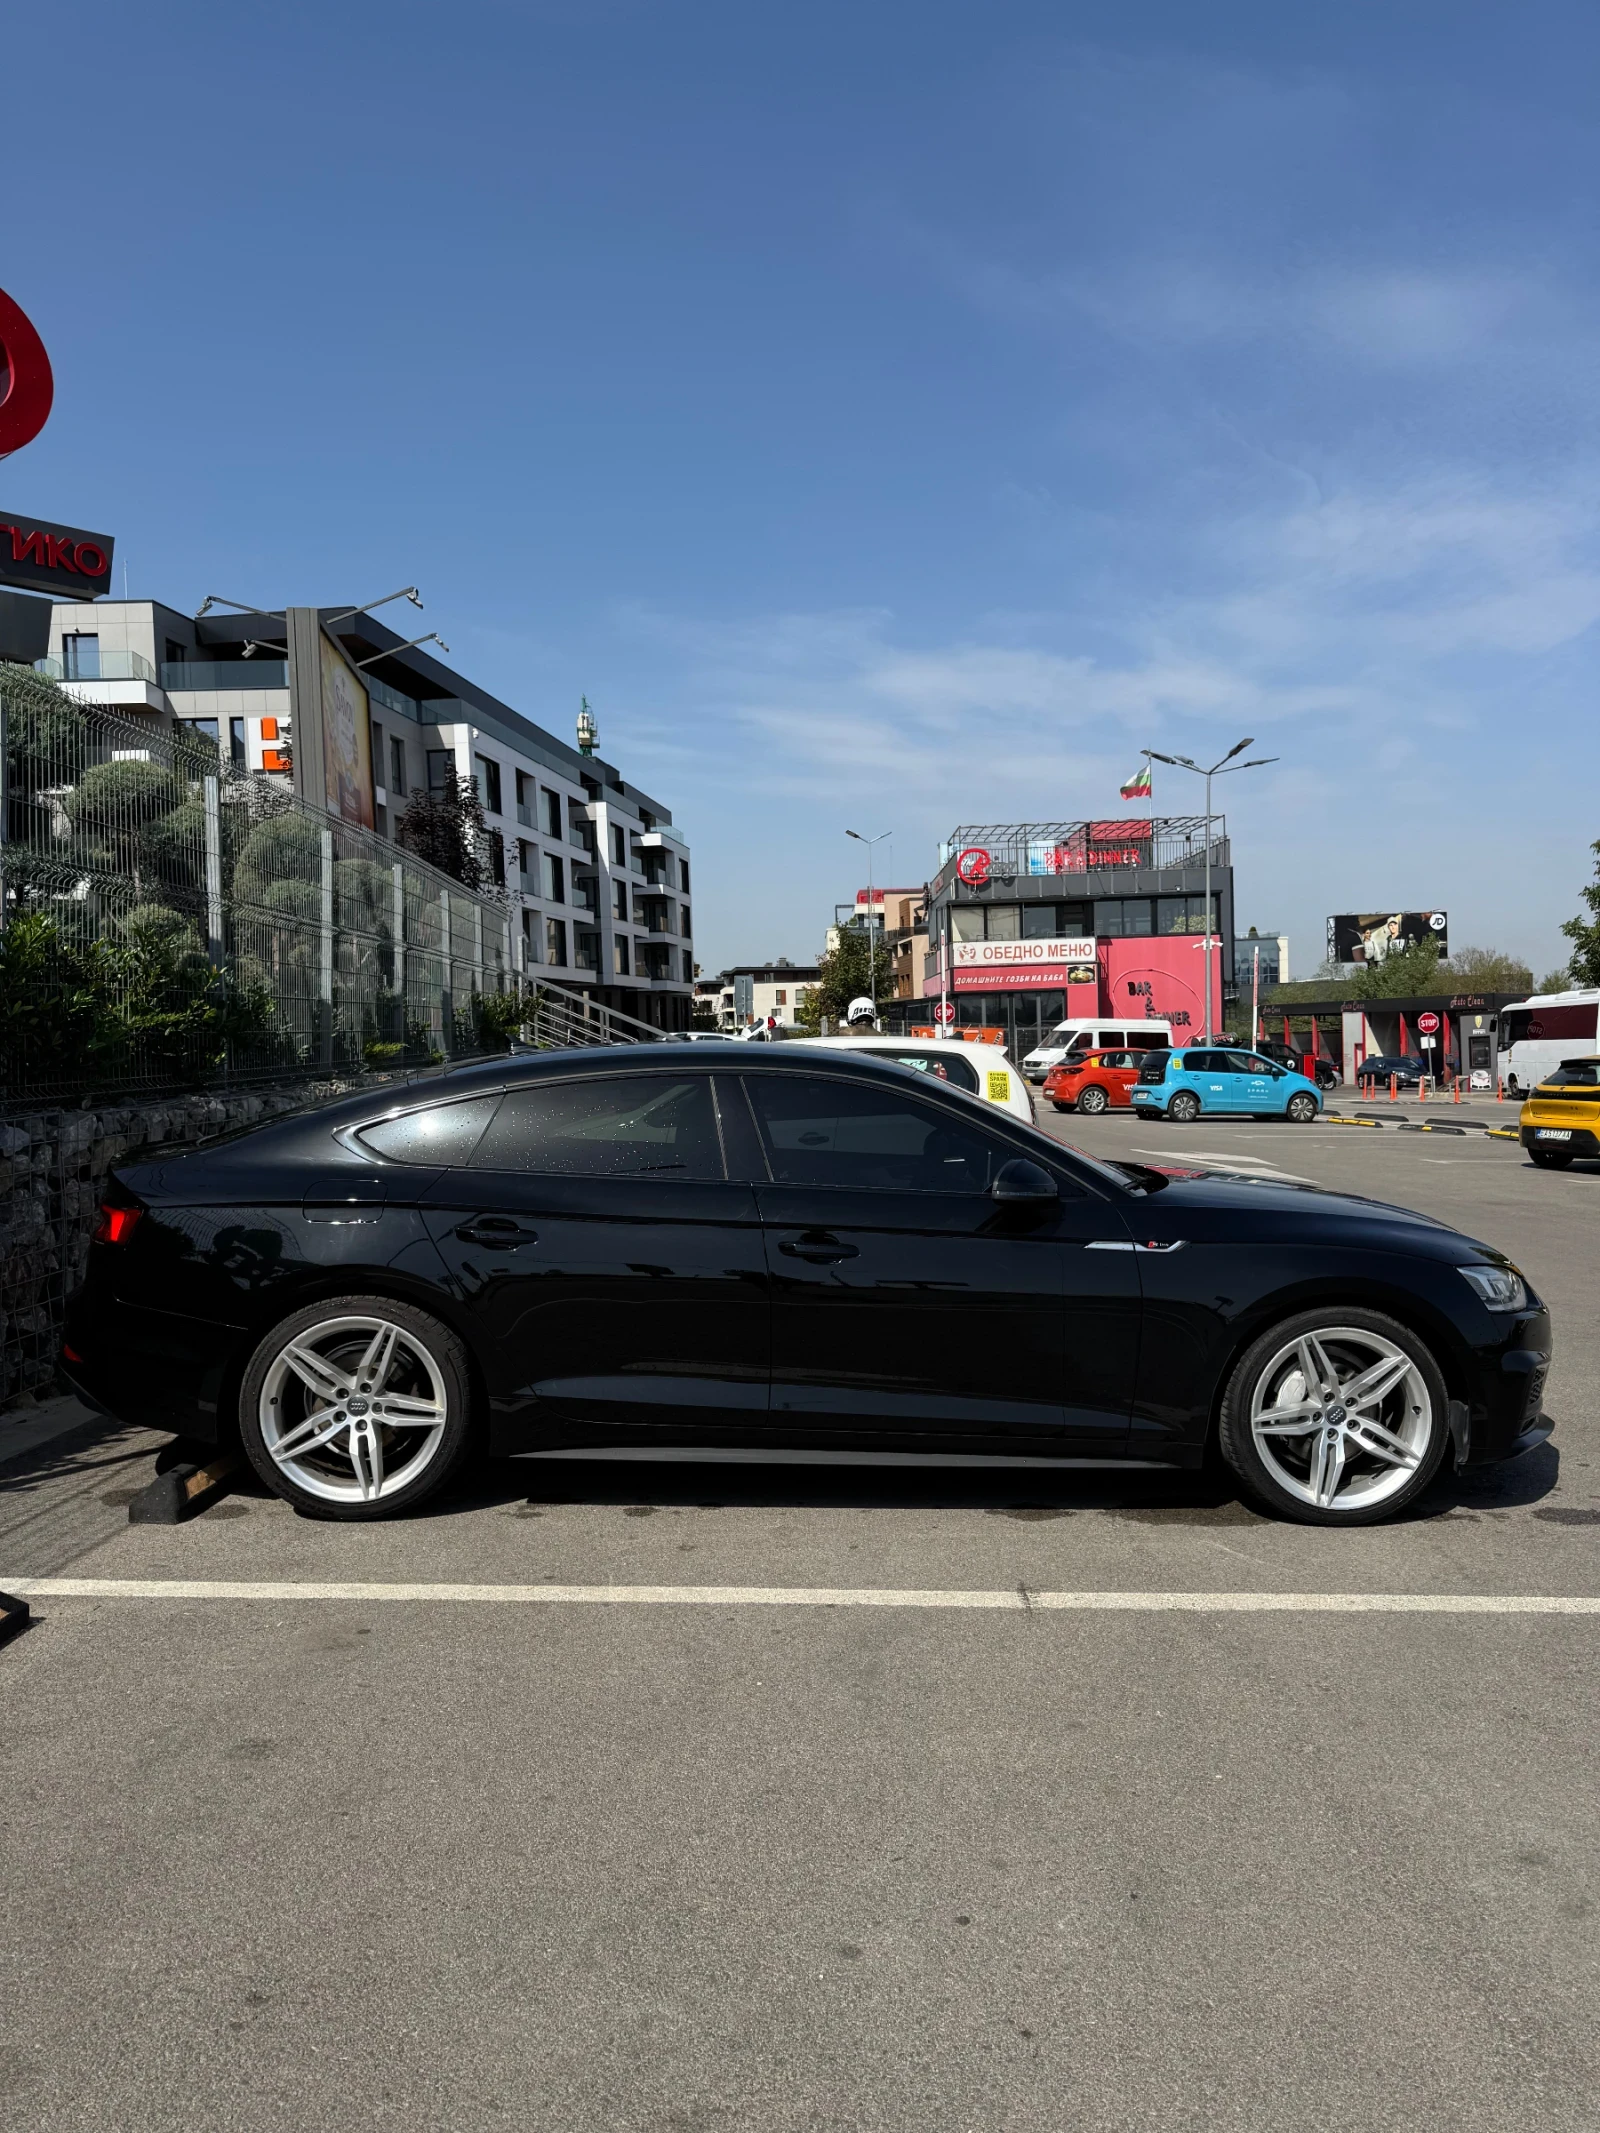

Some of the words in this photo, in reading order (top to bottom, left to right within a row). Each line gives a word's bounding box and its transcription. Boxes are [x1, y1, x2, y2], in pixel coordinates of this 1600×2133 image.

[1088, 848, 1141, 866] DINNER
[1432, 917, 1444, 926] JD
[983, 945, 1043, 961] ОБЕДНО
[1048, 943, 1093, 957] МЕНЮ
[1005, 974, 1030, 983] ГОЗБИ
[1031, 974, 1042, 982] НА
[1043, 973, 1064, 982] БАБА
[1128, 981, 1153, 997] BAR
[1145, 997, 1156, 1012] &
[936, 1009, 953, 1017] SOP
[1420, 1019, 1437, 1027] STOP
